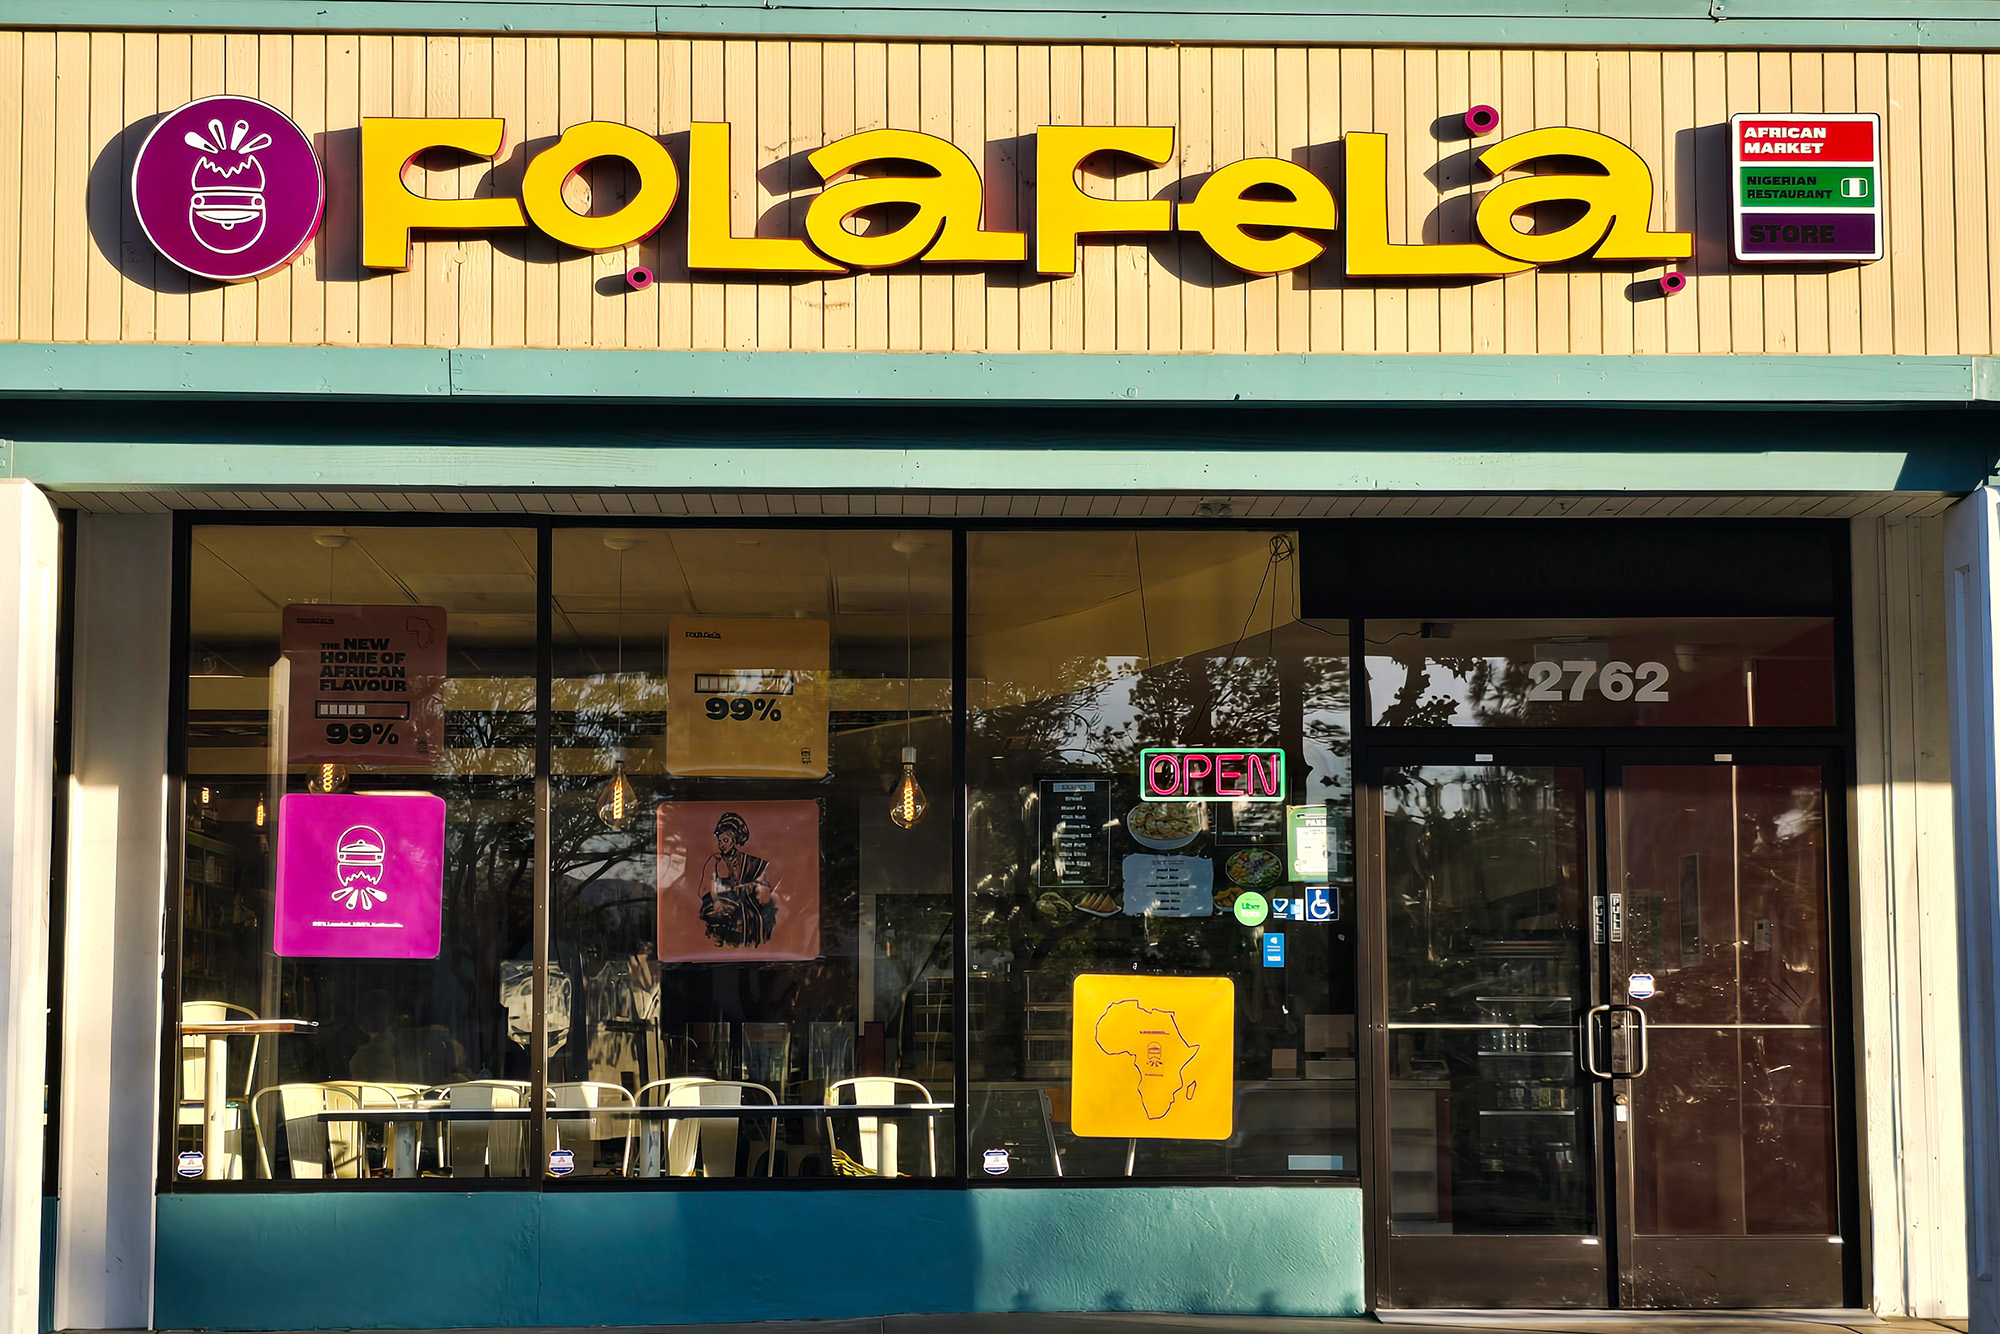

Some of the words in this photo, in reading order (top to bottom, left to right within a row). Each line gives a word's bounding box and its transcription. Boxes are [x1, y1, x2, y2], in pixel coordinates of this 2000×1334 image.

[1744, 127, 1827, 139] AFRICAN
[1744, 142, 1824, 154] MARKET
[1747, 176, 1817, 185] NIGERIAN
[1747, 190, 1833, 199] RESTAURANT
[1750, 225, 1835, 243] STORE
[343, 638, 390, 650] NEW
[320, 652, 377, 664] HOME
[380, 653, 406, 664] OF
[320, 666, 406, 678] AFRICAN
[320, 679, 407, 692] FLAVOUR
[1528, 661, 1669, 702] 2762
[705, 697, 782, 721] 99%
[326, 723, 399, 745] 99%
[1149, 754, 1277, 795] OPEN
[1241, 902, 1260, 910] Uber
[1613, 898, 1621, 929] PULL
